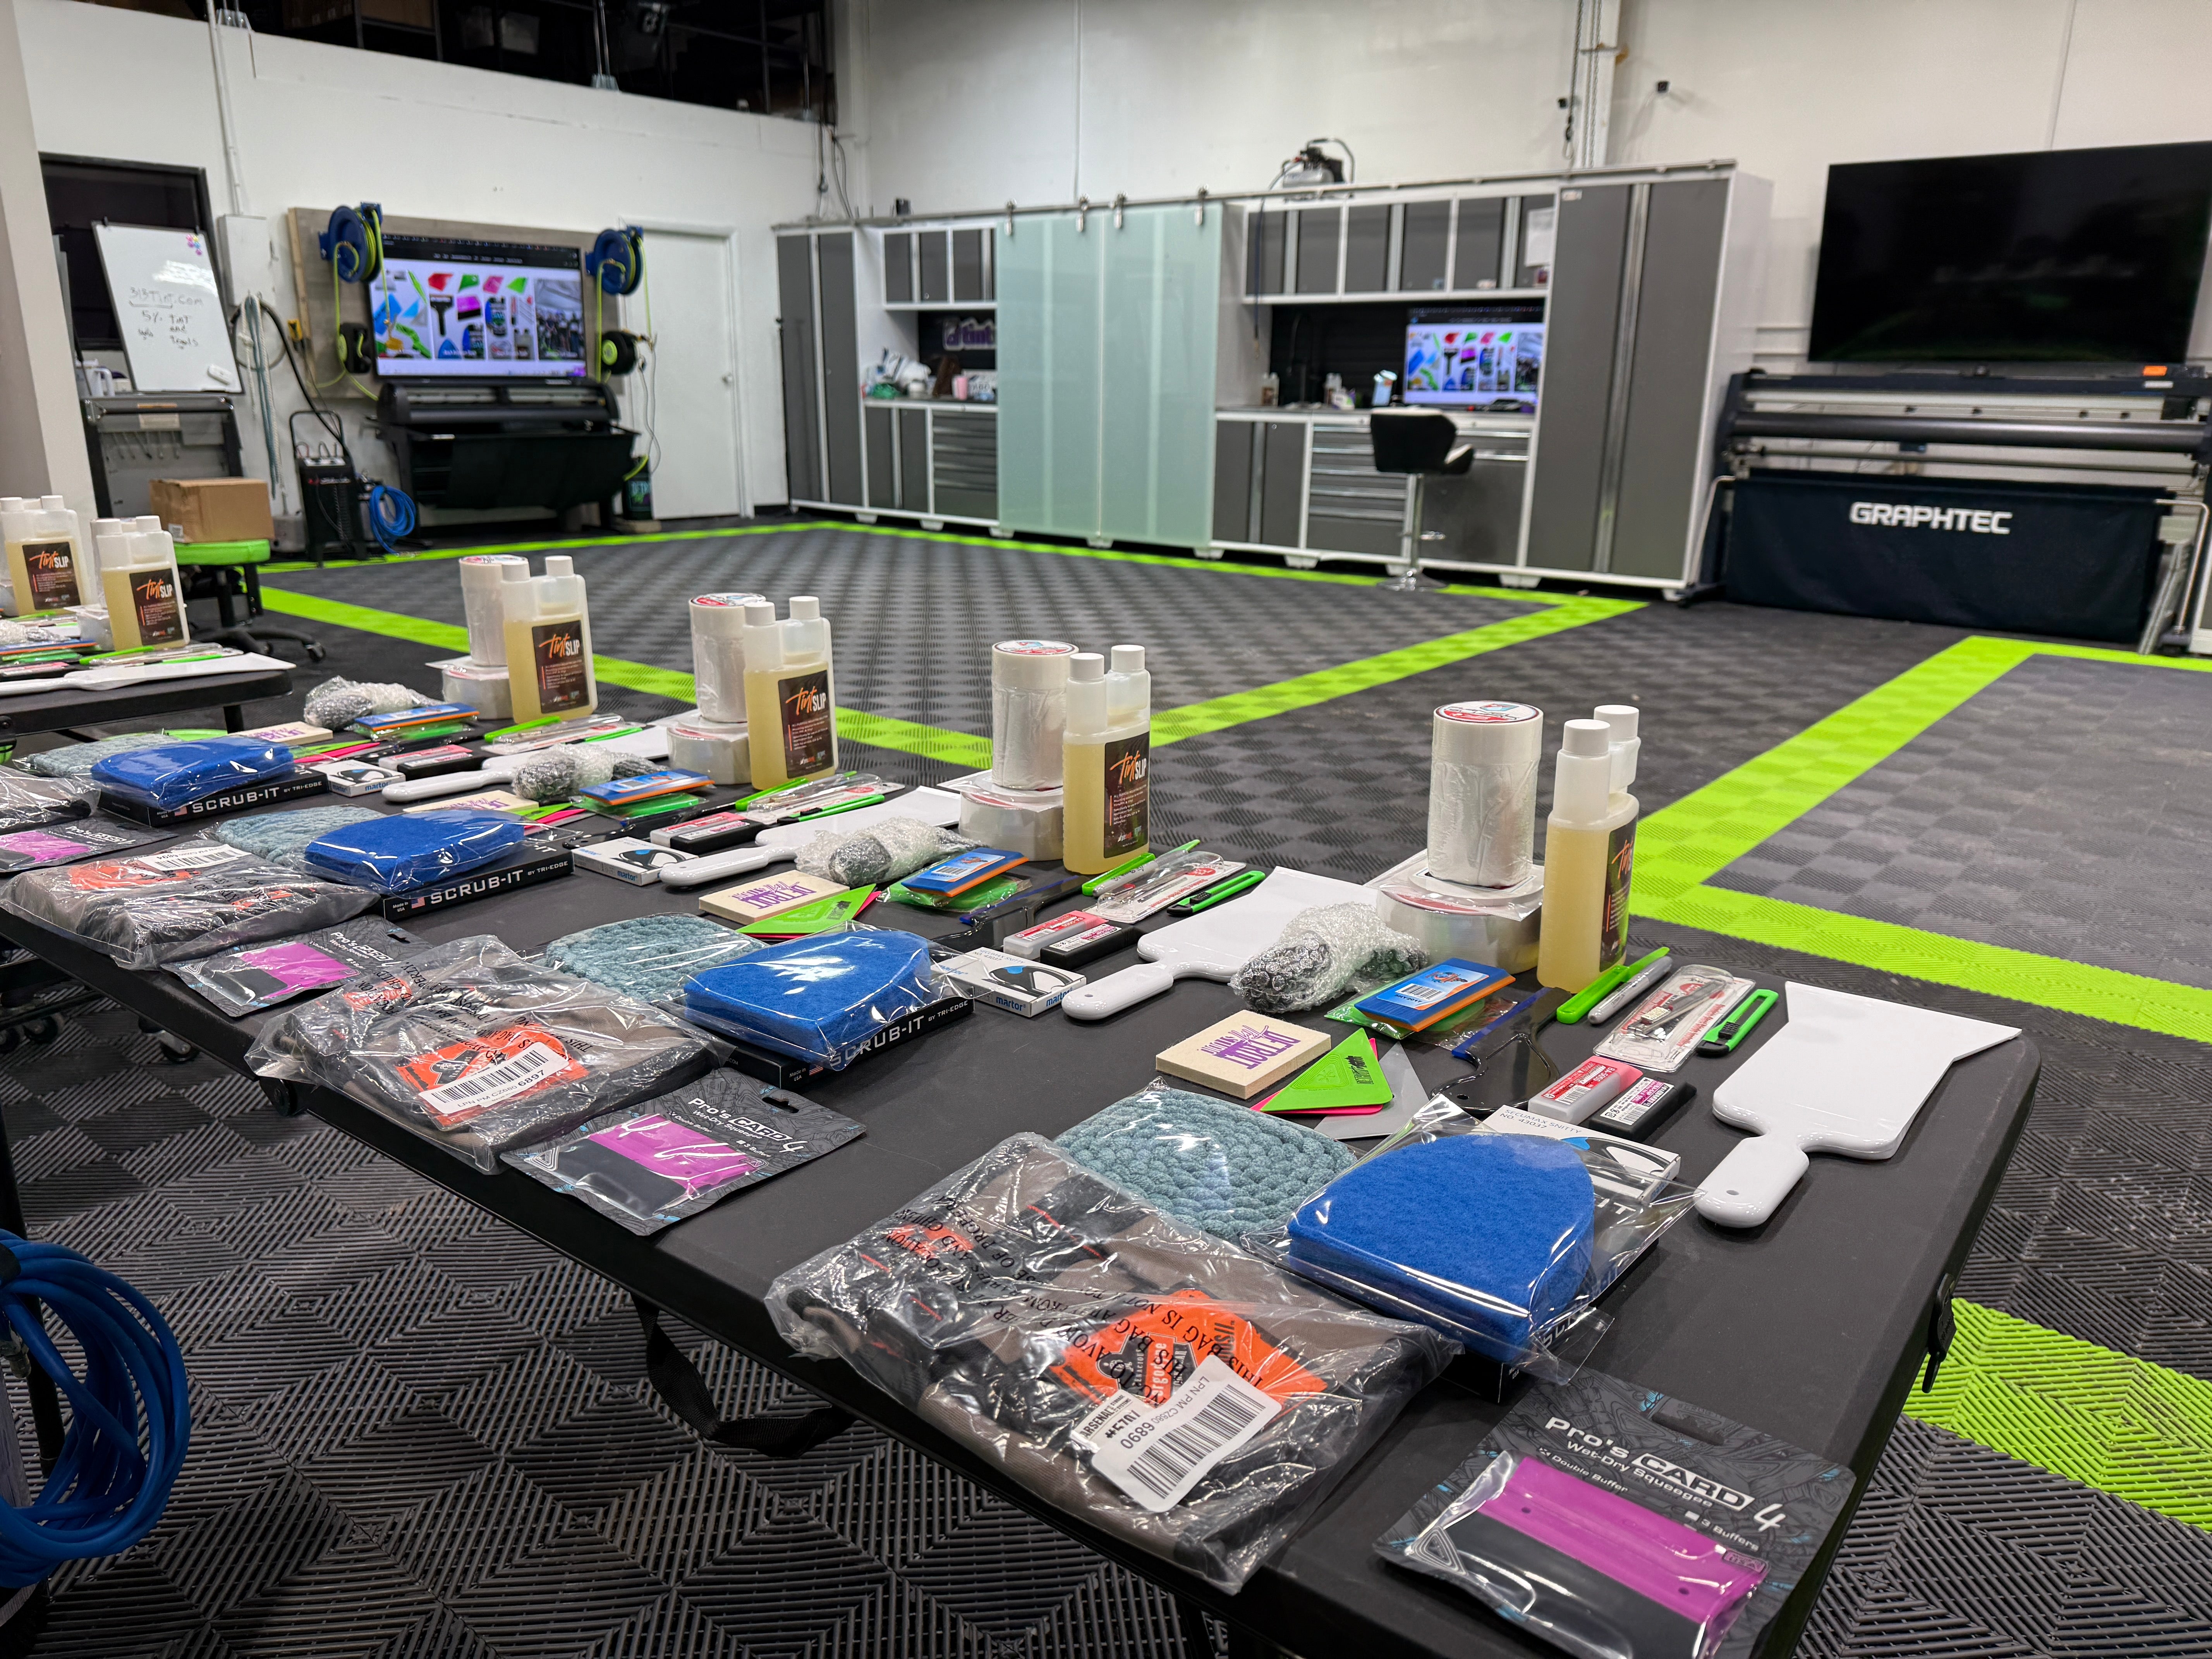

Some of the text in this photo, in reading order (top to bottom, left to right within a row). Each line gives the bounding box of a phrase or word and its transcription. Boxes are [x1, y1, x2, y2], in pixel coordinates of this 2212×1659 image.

[1849, 501, 2013, 535] GRAPHTEC
[54, 556, 69, 568] SLIP
[160, 584, 173, 598] SLIP
[566, 639, 580, 656] SLIP
[812, 692, 827, 712] SLIP
[1135, 758, 1147, 780] SLIP
[191, 787, 280, 814] SCRUB-IT
[430, 870, 524, 904] SCRUB-IT
[617, 870, 636, 881] martor
[330, 931, 358, 947] Pro's
[996, 996, 1024, 1011] martor
[830, 1015, 925, 1066] SCRUB-IT
[1223, 1030, 1302, 1070] DETROIT
[457, 1099, 476, 1108] LPN
[476, 1095, 491, 1104] PM
[517, 1069, 546, 1087] 6897
[687, 1097, 732, 1120] Pro's
[735, 1118, 789, 1140] CARD
[692, 1110, 763, 1139] Wet-Dry Squeegee
[1499, 1112, 1548, 1129] NO. 43037
[1504, 1109, 1582, 1134] SECUMAX SNITTY
[992, 1251, 1015, 1268] OF
[1124, 1296, 1161, 1314] NOT
[1161, 1309, 1185, 1330] IS
[1114, 1318, 1155, 1353] BAG
[1183, 1325, 1223, 1356] BAG
[1154, 1348, 1188, 1382] HIS
[1228, 1356, 1264, 1388] THIS
[1190, 1376, 1210, 1396] LPN
[1178, 1394, 1194, 1409] PM
[1080, 1406, 1114, 1438] ARSENAL
[1151, 1408, 1179, 1424] CZ680
[1120, 1422, 1155, 1449] 6890
[1544, 1416, 1786, 1532] Pro's CARD 4
[1551, 1454, 1628, 1493] Double Buffer
[1566, 1441, 1714, 1508] Wet-Dry Squeegee
[1701, 1518, 1760, 1552] 3 Buffers
